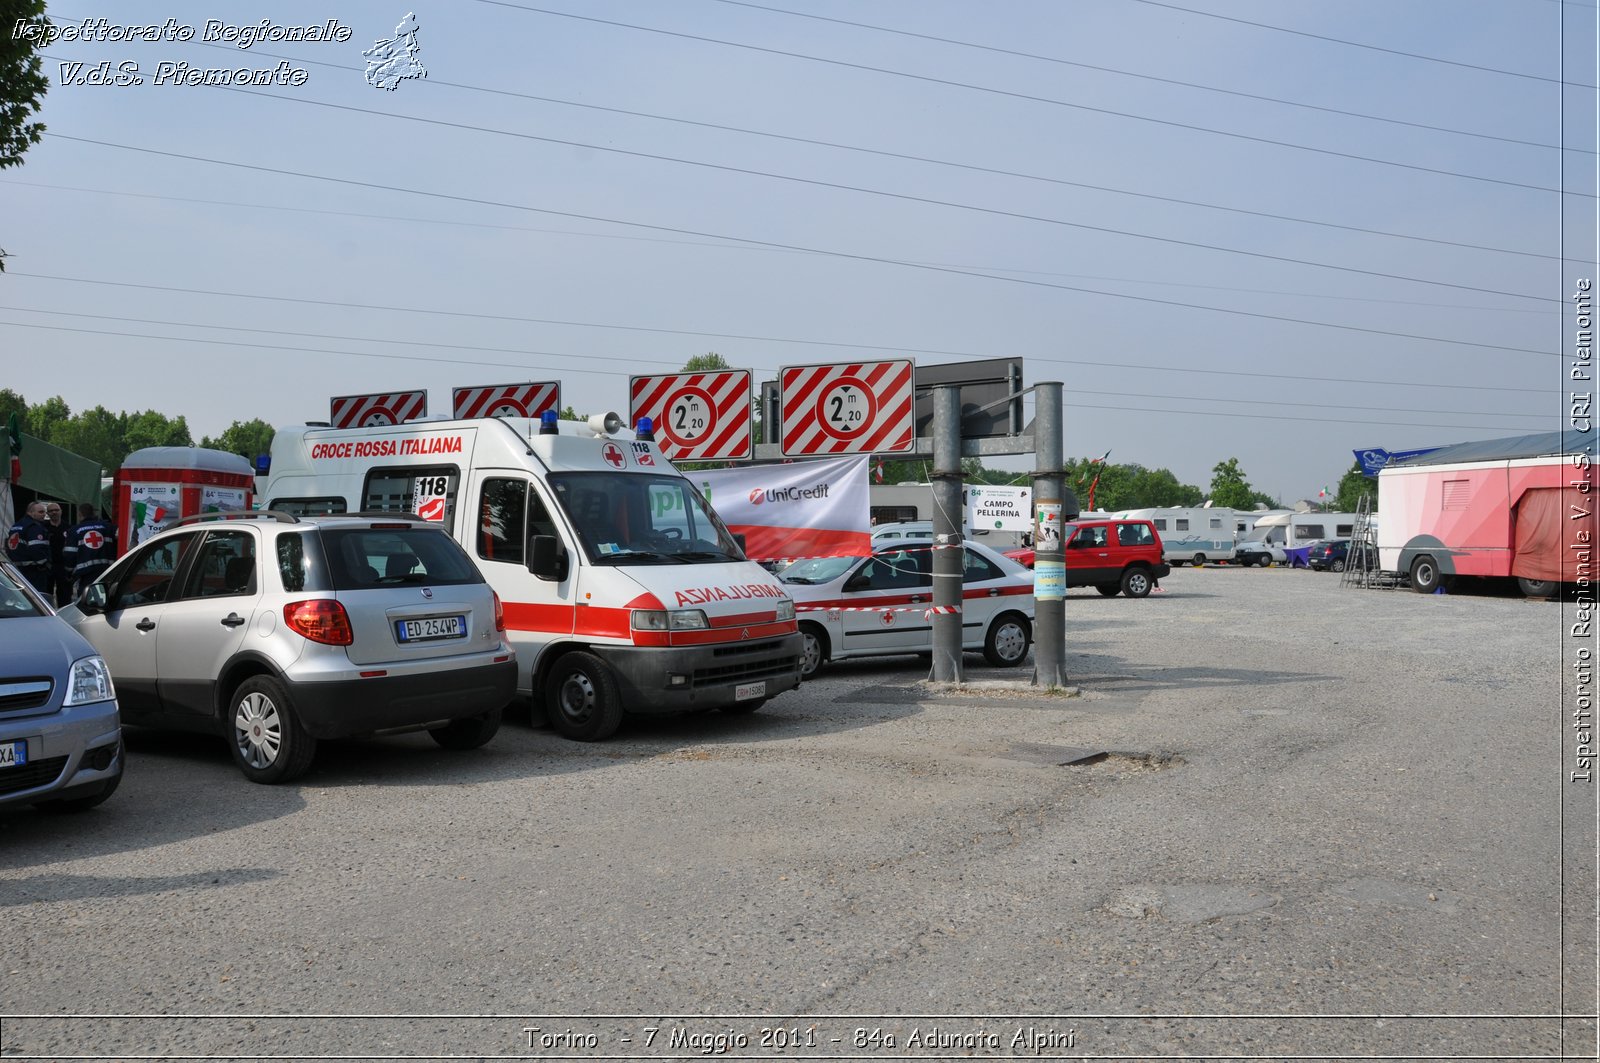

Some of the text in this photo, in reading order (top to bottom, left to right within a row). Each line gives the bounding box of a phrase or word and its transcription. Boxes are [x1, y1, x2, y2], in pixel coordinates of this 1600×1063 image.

[312, 436, 463, 459] CROCE ROSSA ITALIANA
[632, 442, 650, 453] 118
[420, 477, 447, 496] 118
[766, 483, 829, 503] UniCredit
[984, 500, 1014, 508] CAMPO
[977, 509, 1020, 517] PELLERINA
